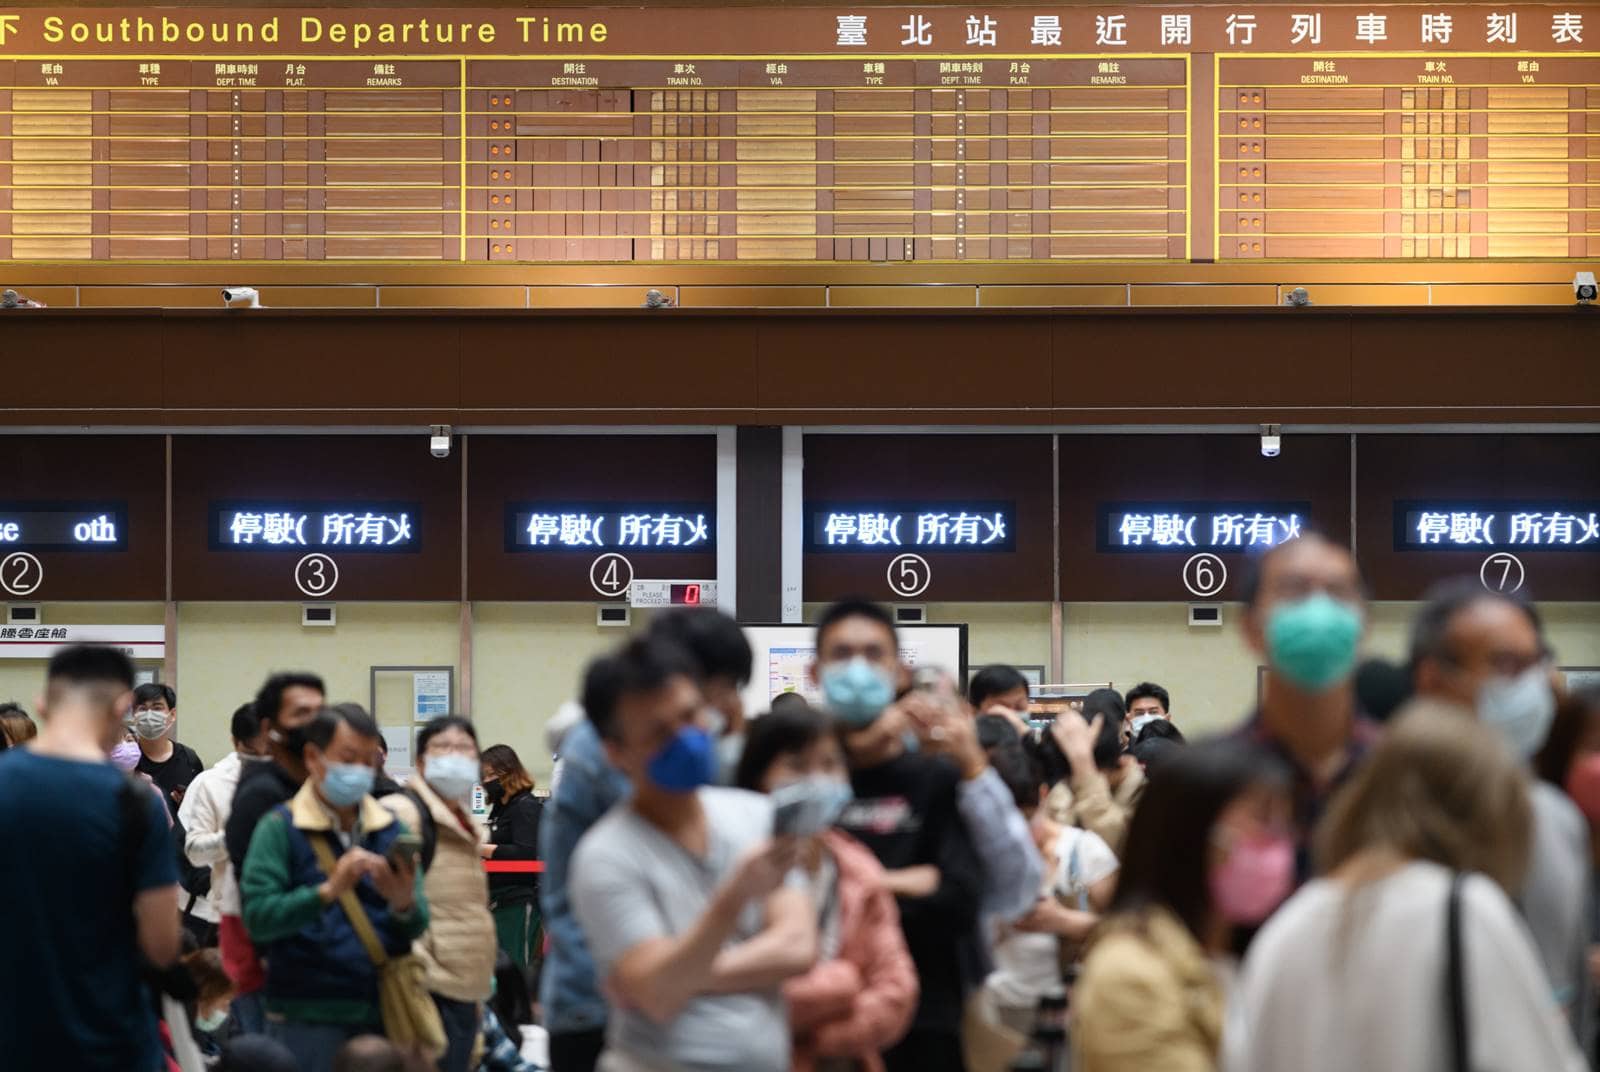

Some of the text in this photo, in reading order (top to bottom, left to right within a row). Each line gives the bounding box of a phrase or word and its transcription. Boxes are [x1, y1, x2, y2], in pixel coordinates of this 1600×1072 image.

[43, 16, 279, 43] Southbound
[301, 17, 496, 48] Departure
[516, 17, 608, 43] Time
[41, 63, 63, 75] 經由
[139, 63, 161, 75] 車種
[215, 63, 258, 75] 開車時刻
[285, 63, 306, 75] 月台
[373, 63, 395, 75] 備註
[563, 63, 586, 74] 開往
[674, 63, 696, 74] 車次
[766, 63, 788, 74] 經由
[863, 62, 885, 74] 車種
[940, 62, 983, 74] 開車時刻
[1009, 62, 1031, 74] 月台
[1098, 62, 1120, 74] 備註
[1313, 61, 1336, 73] 開往
[1424, 61, 1447, 73] 車次
[1517, 61, 1540, 73] 經由
[45, 77, 59, 86] VIA
[141, 77, 159, 86] TYPE
[238, 77, 257, 86] TIME
[366, 77, 402, 86] REMARKS
[551, 77, 598, 86] DESTINATION
[667, 77, 689, 85] TRAIN
[770, 77, 783, 85] VIA
[866, 76, 883, 85] TYPE
[963, 76, 982, 85] TIME
[1090, 76, 1127, 85] REMARKS
[1300, 75, 1349, 84] DESTINATION
[1417, 75, 1440, 84] TRAIN
[1521, 75, 1535, 84] VIA
[685, 584, 700, 604] 0
